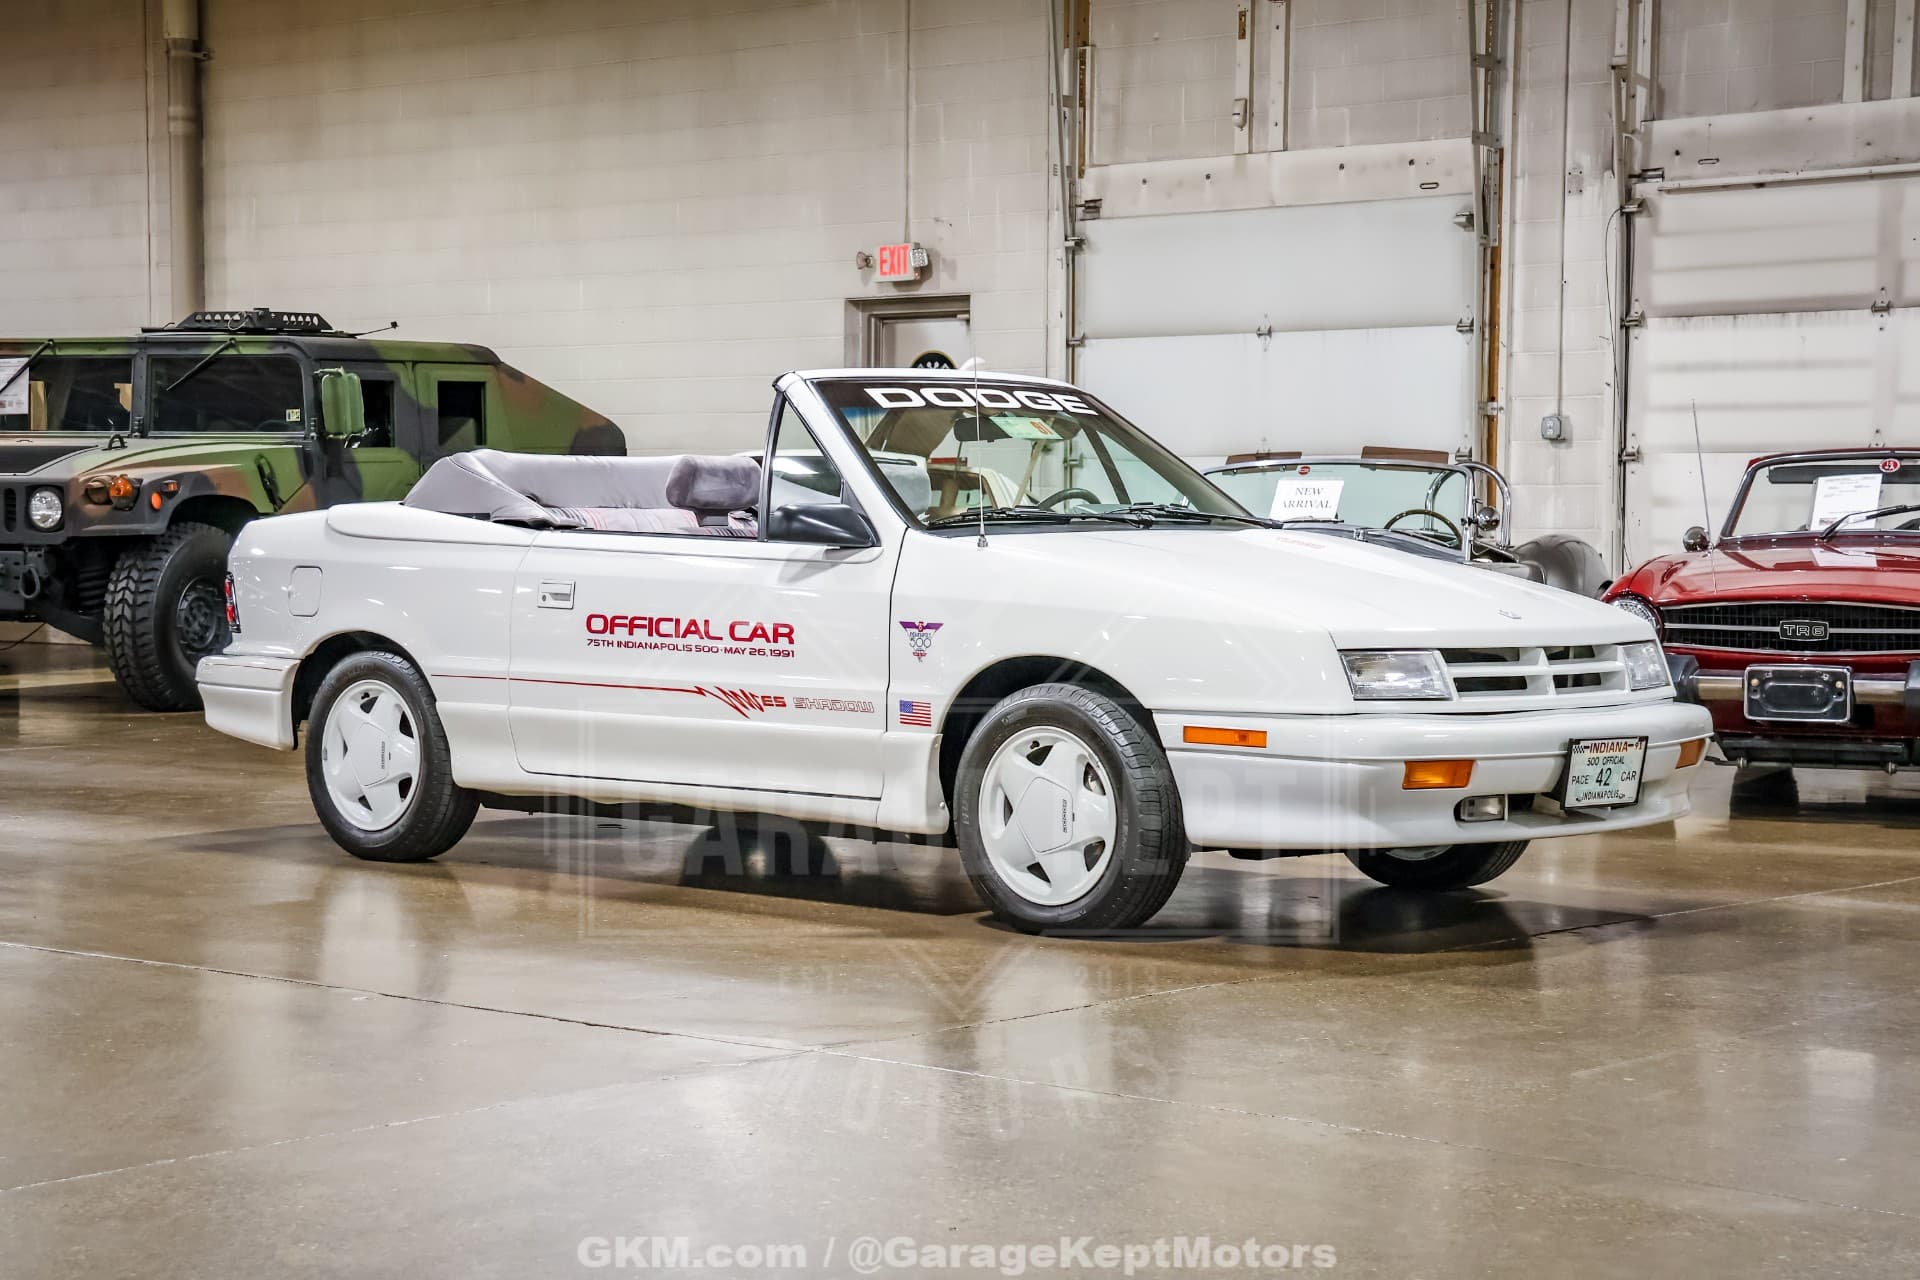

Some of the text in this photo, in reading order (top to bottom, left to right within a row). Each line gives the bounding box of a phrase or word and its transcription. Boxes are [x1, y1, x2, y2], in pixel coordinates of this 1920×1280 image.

[879, 244, 911, 276] EXIT
[863, 387, 1099, 416] DODGE
[1296, 487, 1324, 496] NEW
[1282, 499, 1333, 509] ARRIVAL
[585, 613, 795, 645] OFFICIAL CAR
[586, 638, 614, 648] 75TH
[617, 640, 693, 653] INDIANAPOLIS
[793, 697, 875, 714] SHADOW
[1589, 740, 1629, 754] INDIANA
[1586, 755, 1625, 767] 500 OFFICIAL
[1571, 767, 1637, 787] PACE 42 CAR
[1580, 790, 1620, 801] INDIANAPOLIS
